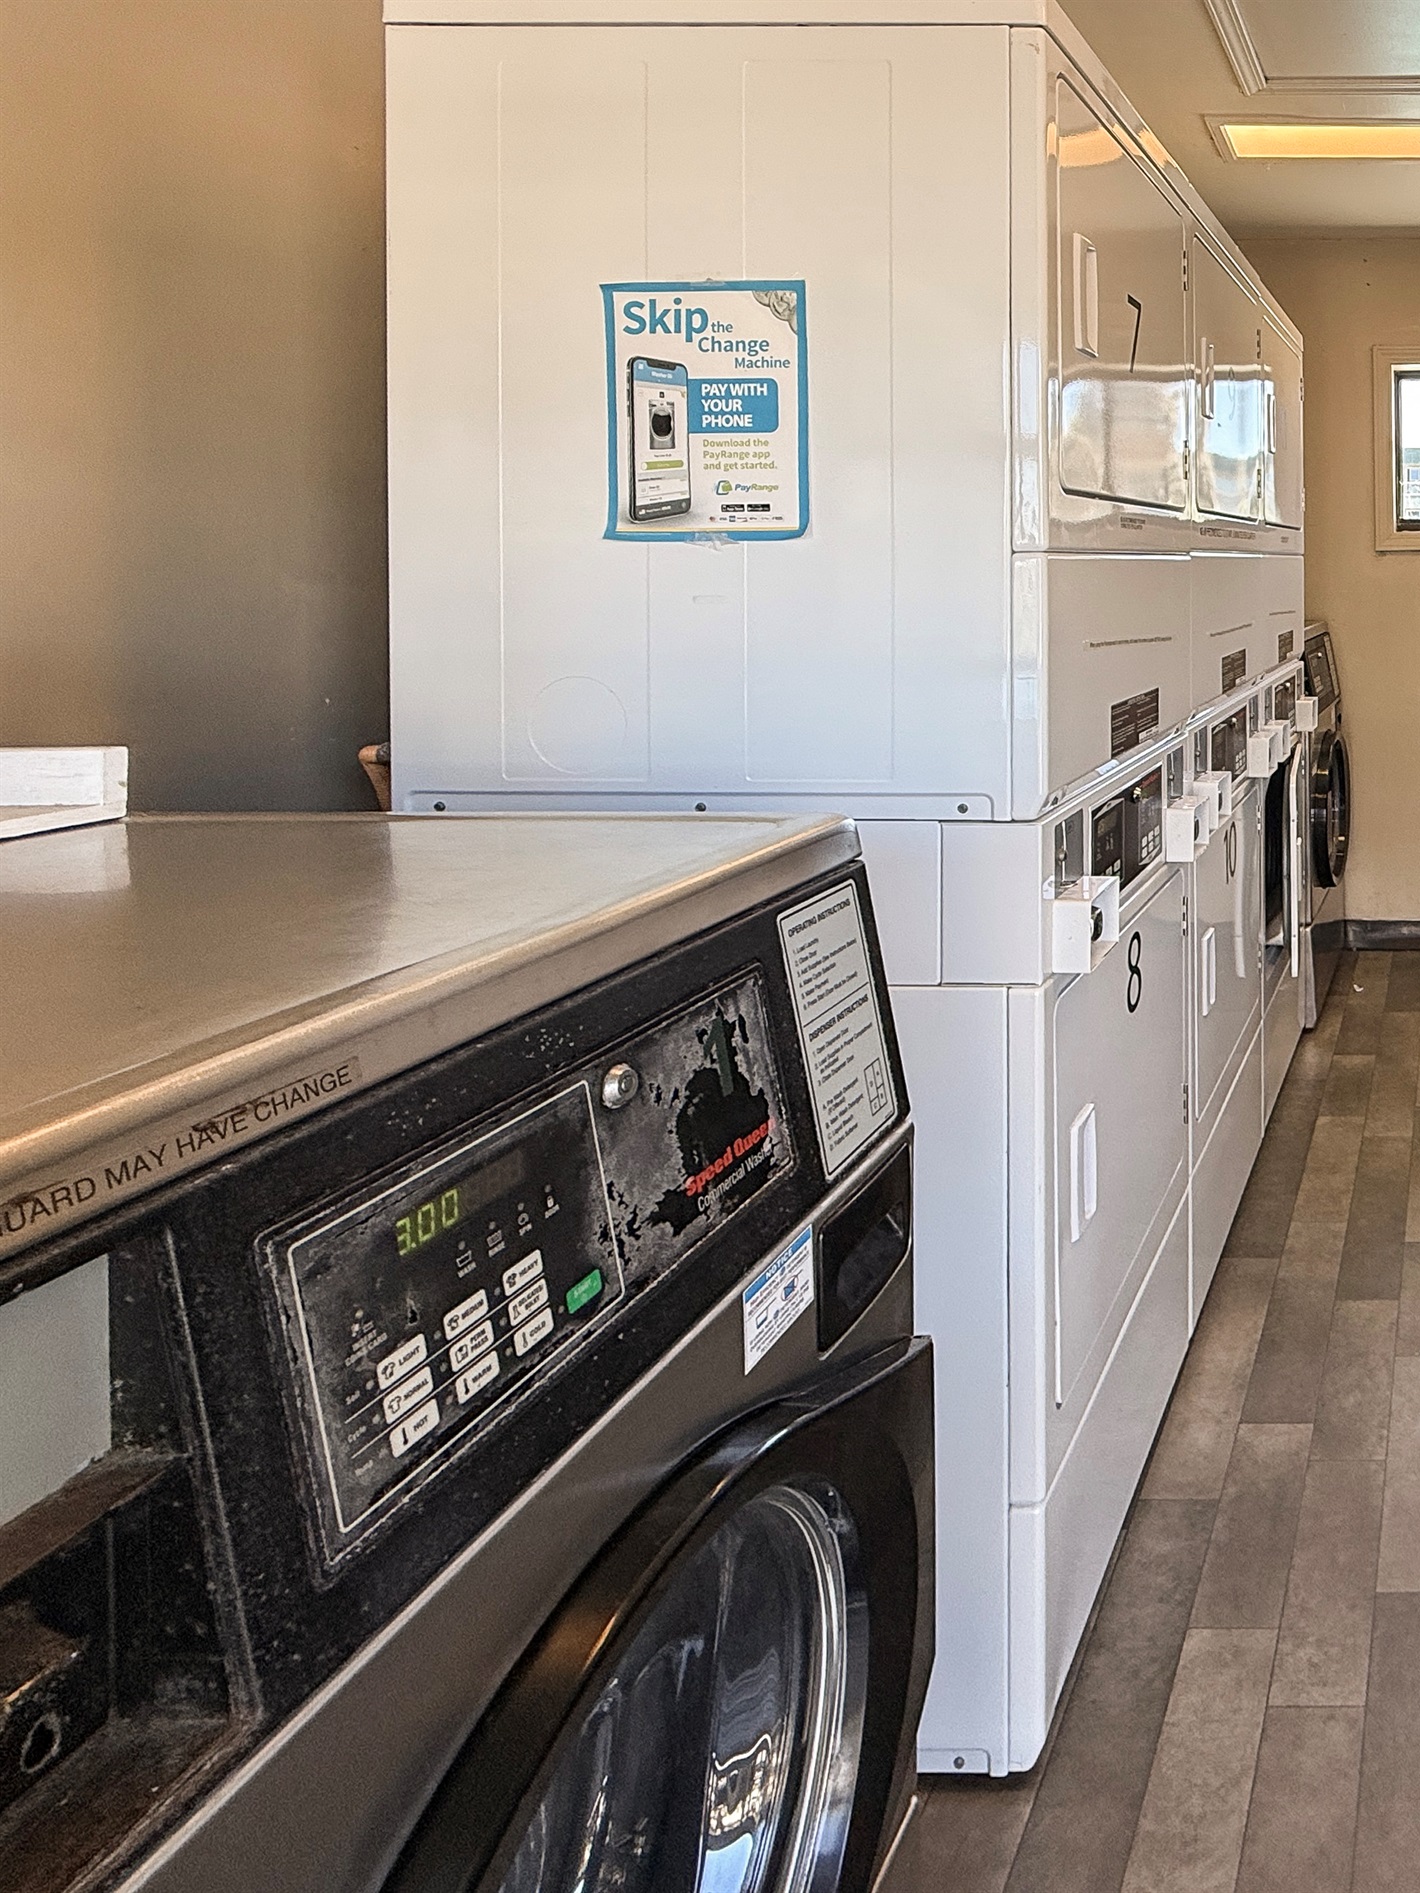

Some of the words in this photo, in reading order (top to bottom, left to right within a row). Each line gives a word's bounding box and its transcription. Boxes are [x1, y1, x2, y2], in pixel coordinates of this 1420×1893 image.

[623, 298, 709, 342] Skip
[711, 321, 733, 333] the
[1127, 293, 1141, 374] 7
[698, 337, 770, 356] Change
[734, 356, 791, 369] Machine
[701, 383, 729, 396] PAY
[730, 383, 768, 396] WITH
[701, 399, 743, 412] YOUR
[702, 414, 753, 428] PHONE
[703, 438, 750, 448] Download
[753, 438, 769, 448] the
[703, 450, 750, 460] PayRange
[752, 451, 770, 460] app
[703, 461, 721, 471] and
[724, 462, 738, 472] get
[740, 460, 778, 470] started.
[734, 483, 779, 493] PayRange
[1223, 820, 1237, 885] 10
[788, 917, 816, 936] OPERATING
[818, 899, 849, 920] INSTRUCTIONS
[1127, 931, 1142, 1014] 8
[809, 1018, 835, 1041] DISPENSER
[837, 995, 867, 1021] INSTRUCTIONS
[703, 1012, 735, 1097] 1
[0, 1177, 96, 1238] UARD
[104, 1144, 167, 1190] MAY
[176, 1110, 250, 1159] HAVE
[254, 1064, 354, 1123] CHANGE
[684, 1146, 733, 1197] Speed
[697, 1162, 746, 1213] Commercial
[395, 1188, 459, 1256] 3.00
[519, 1260, 538, 1277] HEAVY
[764, 1247, 794, 1281] NOTICE
[470, 1329, 485, 1343] PERM
[529, 1320, 545, 1337] COLD
[470, 1335, 488, 1353] PRESS
[398, 1347, 420, 1366] LIGHT
[472, 1364, 491, 1384] WARM
[403, 1378, 428, 1400] NORMAL
[413, 1415, 428, 1431] HOT
